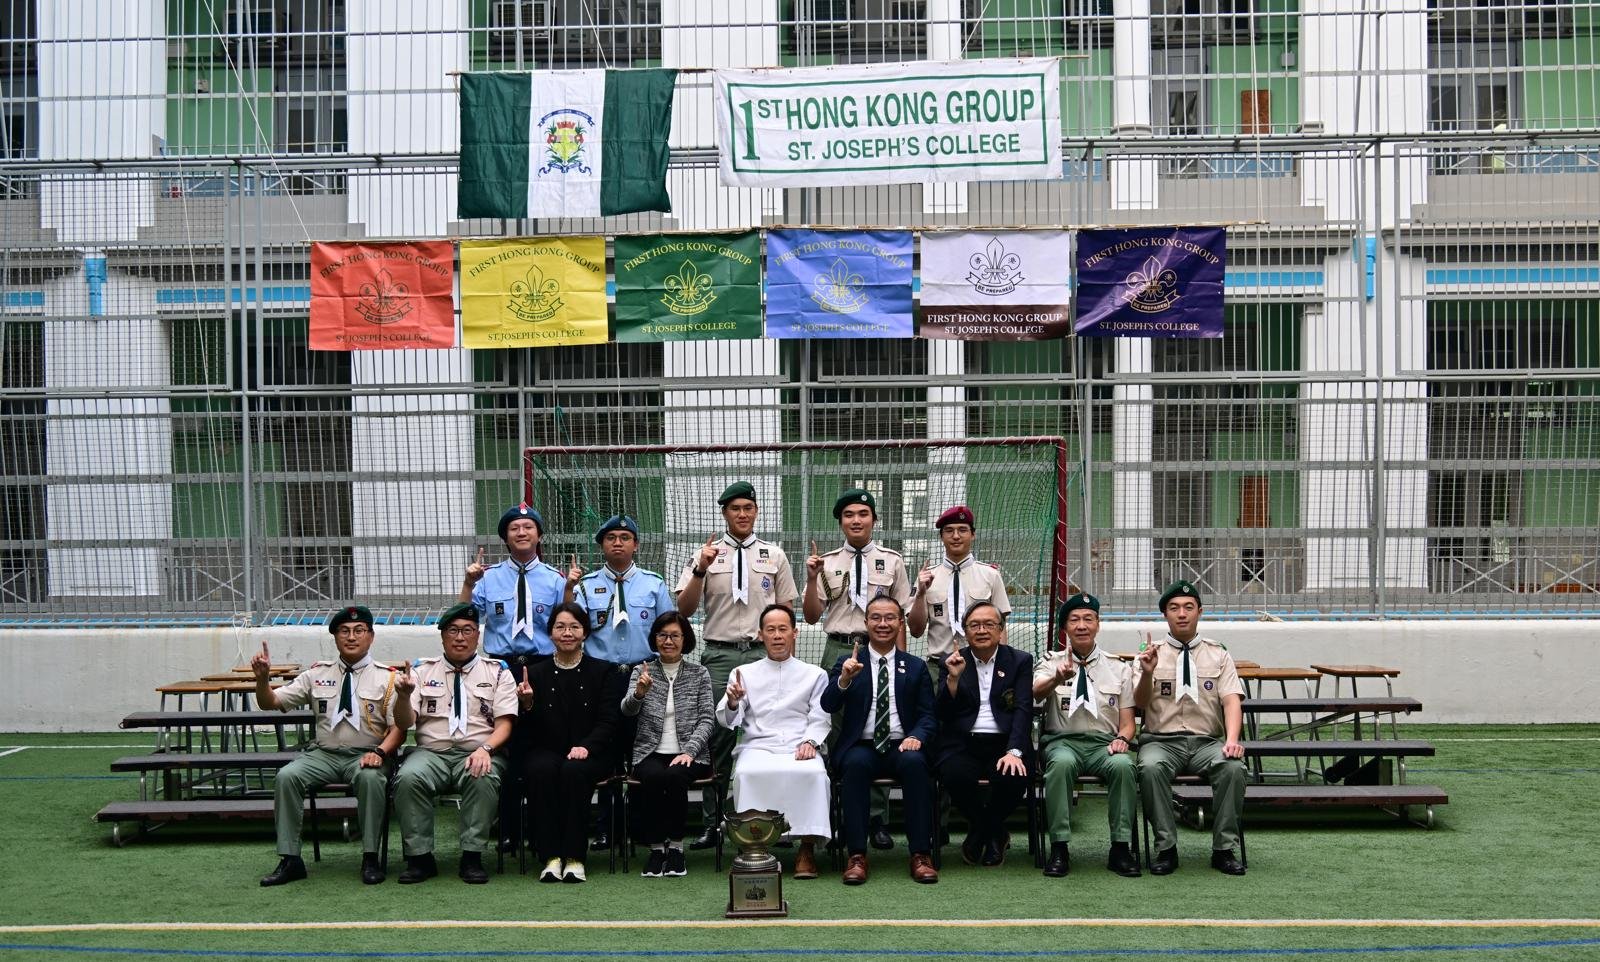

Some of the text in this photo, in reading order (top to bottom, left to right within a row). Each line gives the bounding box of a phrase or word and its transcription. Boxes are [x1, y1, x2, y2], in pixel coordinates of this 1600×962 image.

[785, 95, 858, 130] HONG
[866, 91, 938, 127] KONG
[946, 89, 1035, 124] GROUP
[788, 133, 1021, 161] ST. JOSEPH'S COLLEGE
[469, 247, 600, 277] FIRST HONG KONG GROUP
[624, 242, 752, 272] FIRST HONG KONG GROUP
[774, 239, 907, 269] FIRST HONG KONG GROUP
[1084, 237, 1219, 268] FIRST HONG KONG GROUP
[320, 250, 449, 279] FIRST HONG KONG GROUP
[985, 285, 1013, 294] PREPARED
[1140, 302, 1168, 311] PREPARED
[694, 321, 737, 331] COLLEGE
[927, 313, 1063, 323] FIRST HONG KONG GROUP
[1112, 321, 1154, 331] JOSEPH'S
[1155, 322, 1200, 331] COLLEGE
[542, 328, 586, 338] COLLEGE
[957, 325, 999, 335] JOSEPH'S
[1000, 325, 1045, 334] COLLEGE
